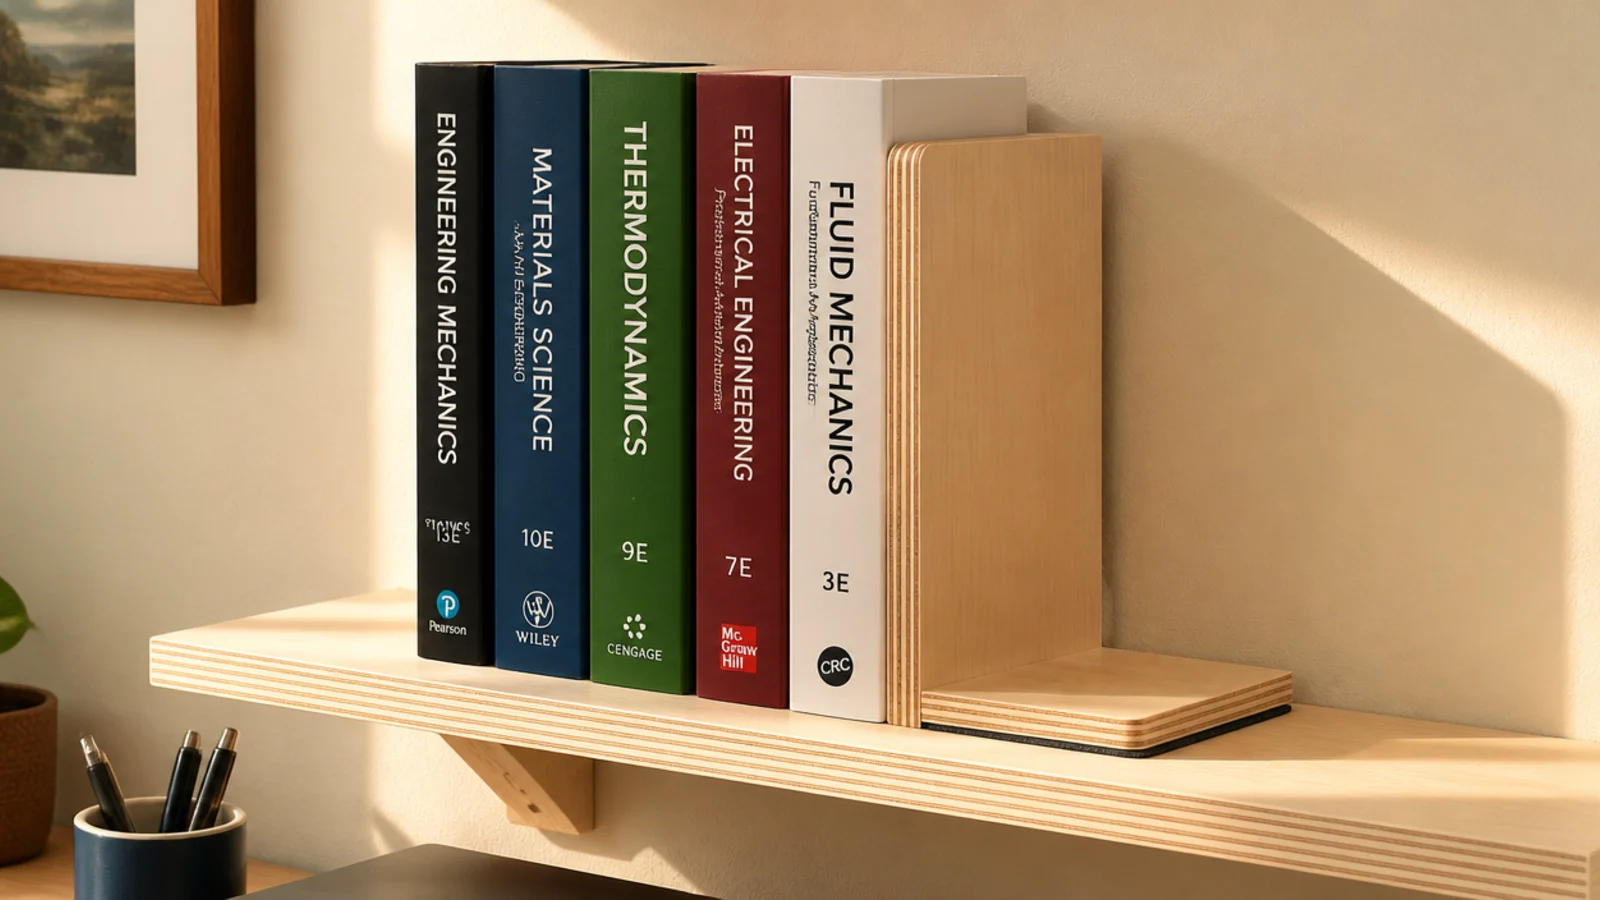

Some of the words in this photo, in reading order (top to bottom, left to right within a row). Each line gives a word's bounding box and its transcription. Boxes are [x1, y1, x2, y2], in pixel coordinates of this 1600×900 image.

[437, 112, 457, 295] ENGINEERING
[531, 147, 553, 316] MATERIALS
[733, 125, 754, 288] ELECTRICAL
[829, 181, 855, 280] FLUID
[623, 121, 648, 456] THERMODYNAMICS
[437, 305, 458, 465] MECHANICS
[532, 325, 554, 452] SCIENCE
[733, 298, 754, 482] ENGINEERING
[828, 292, 855, 496] MECHANICS
[521, 528, 554, 550] 10E
[621, 541, 648, 563] 9E
[725, 555, 752, 578] 7E
[822, 571, 849, 593] 3E
[428, 619, 467, 636] Pearson
[515, 629, 560, 648] WILEY
[607, 643, 663, 662] CENGAGE
[721, 653, 744, 669] Hill
[820, 657, 851, 675] CRC
